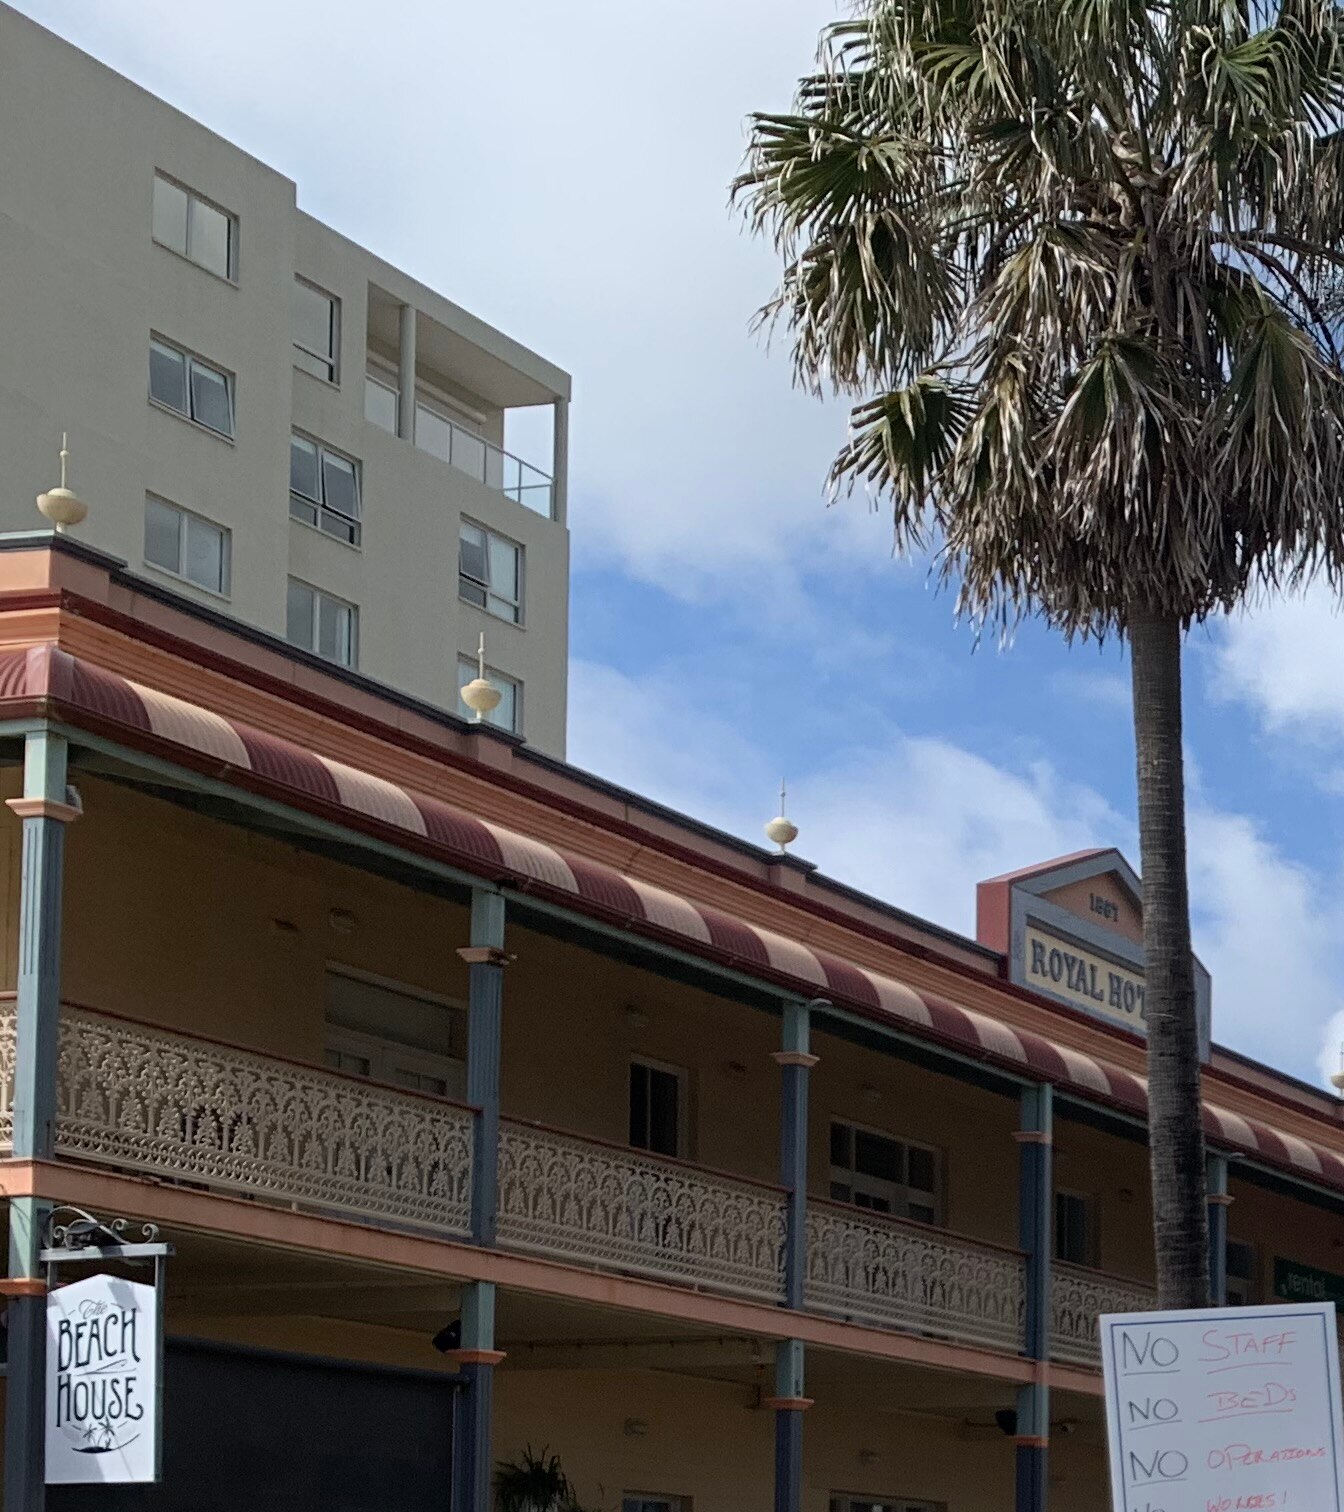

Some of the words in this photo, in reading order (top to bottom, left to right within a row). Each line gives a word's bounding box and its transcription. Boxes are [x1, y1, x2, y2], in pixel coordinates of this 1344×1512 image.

[1032, 938, 1104, 1002] ROYAL
[79, 1299, 109, 1320] The
[57, 1308, 140, 1372] BEACH
[1123, 1331, 1179, 1369] NO
[1198, 1329, 1297, 1361] STAFF
[56, 1373, 144, 1427] HOUSE
[1128, 1397, 1179, 1422] NO
[1130, 1450, 1188, 1480] NO
